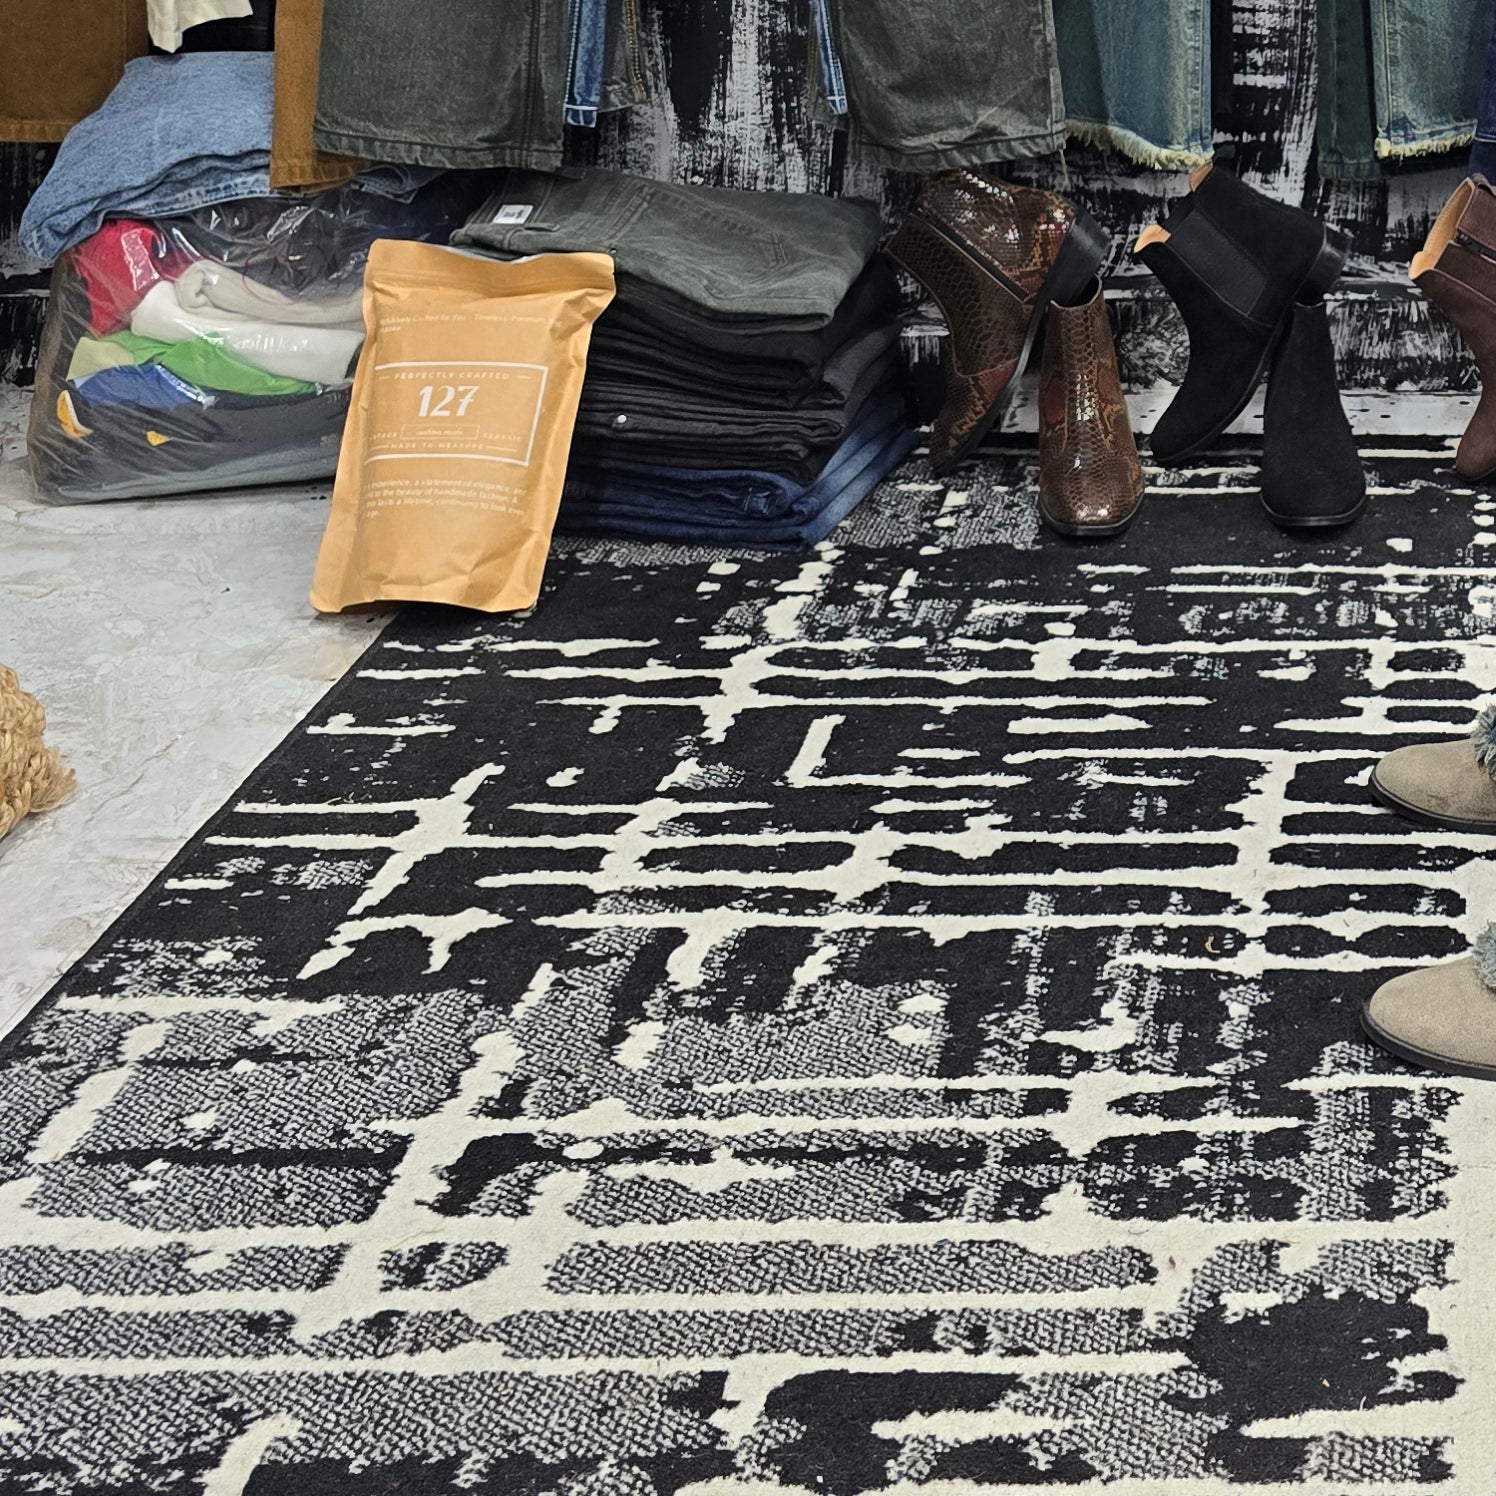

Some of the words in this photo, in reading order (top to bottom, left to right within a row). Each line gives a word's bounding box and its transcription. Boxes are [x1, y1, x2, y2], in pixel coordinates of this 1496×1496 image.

[393, 371, 454, 380] PERFECTLY
[459, 371, 510, 380] CRAFTED
[418, 385, 480, 417] 127
